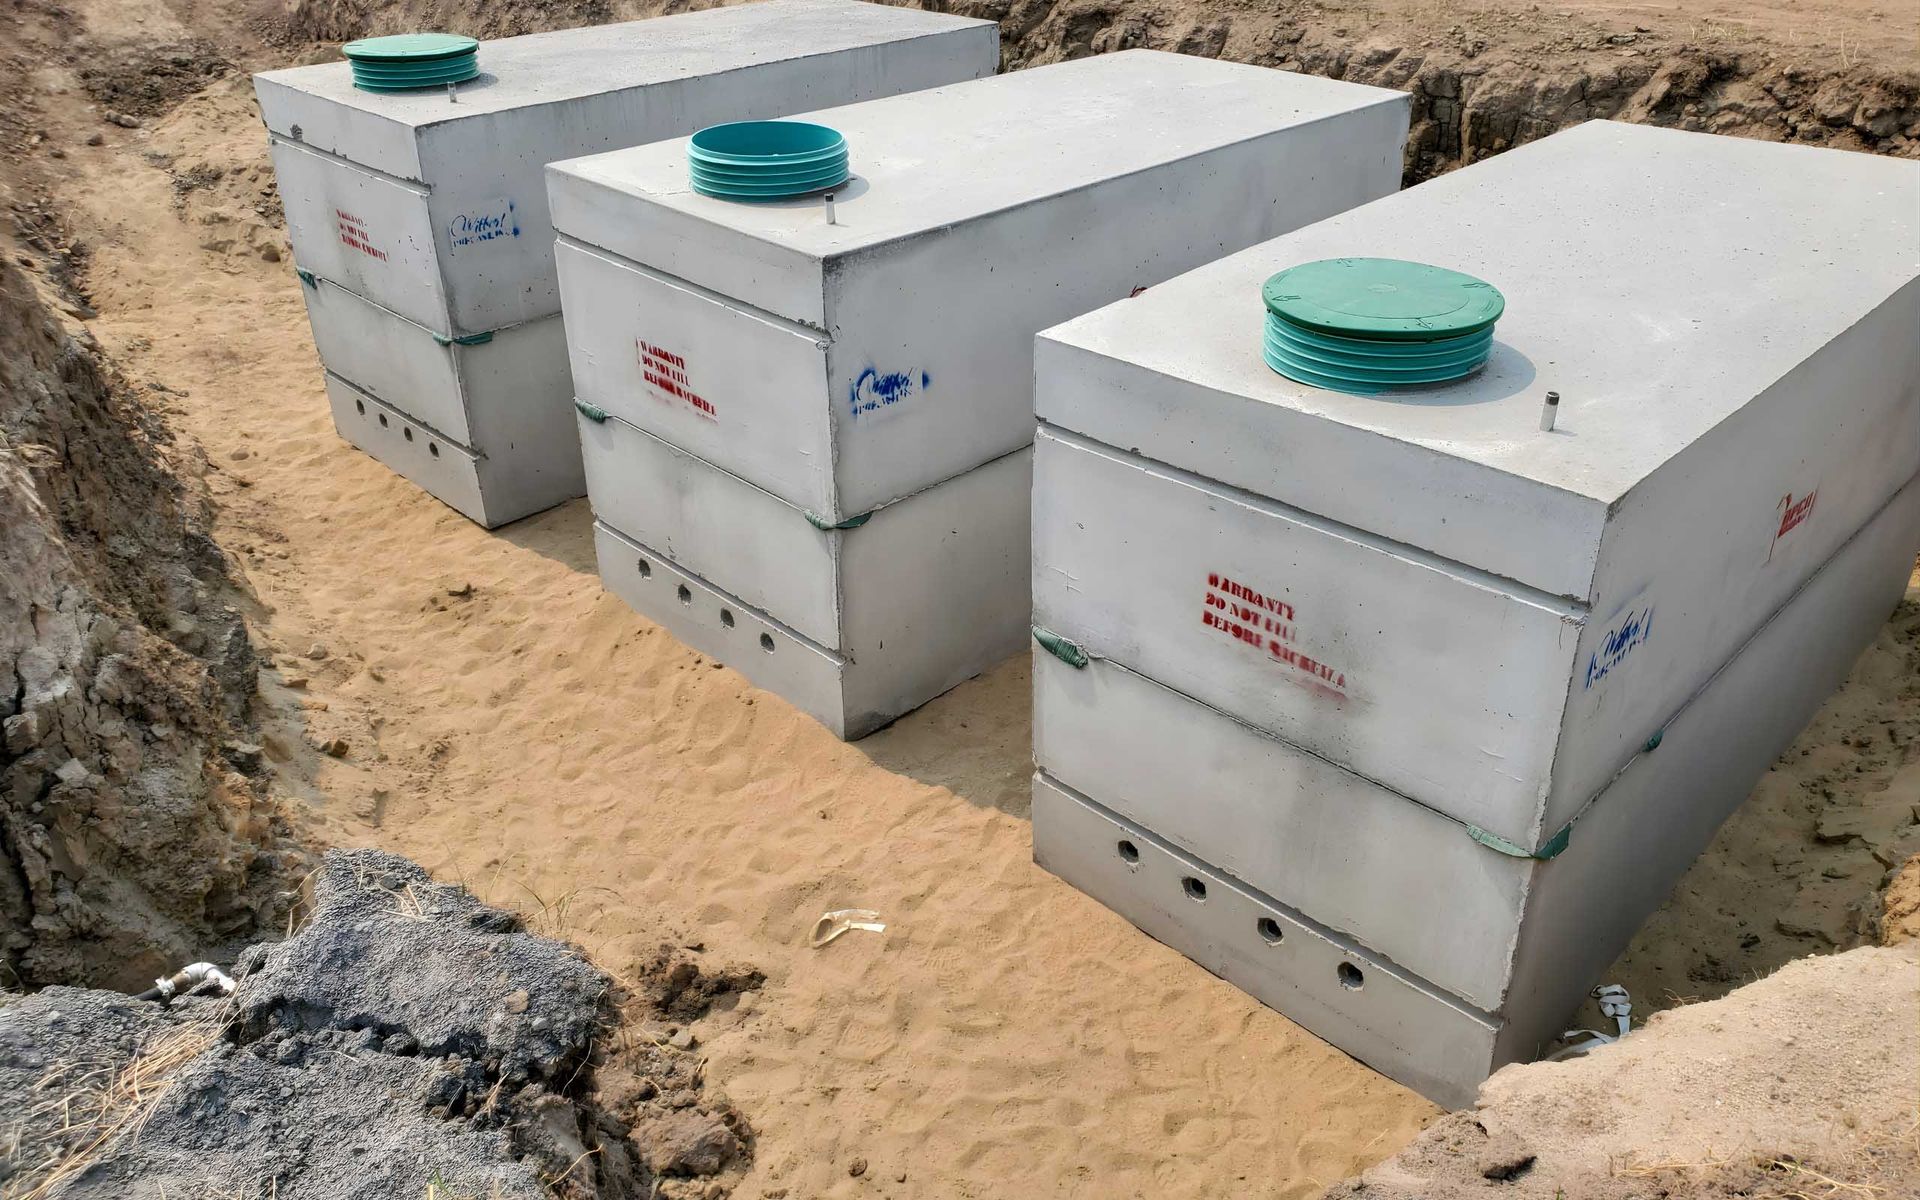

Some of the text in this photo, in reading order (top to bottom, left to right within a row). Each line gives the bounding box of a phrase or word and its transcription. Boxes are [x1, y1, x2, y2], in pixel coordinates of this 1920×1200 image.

[1205, 592, 1226, 610] DO
[1229, 602, 1262, 626] NOT
[1208, 573, 1296, 621] WARRANTY
[1203, 610, 1263, 649] BEFORE
